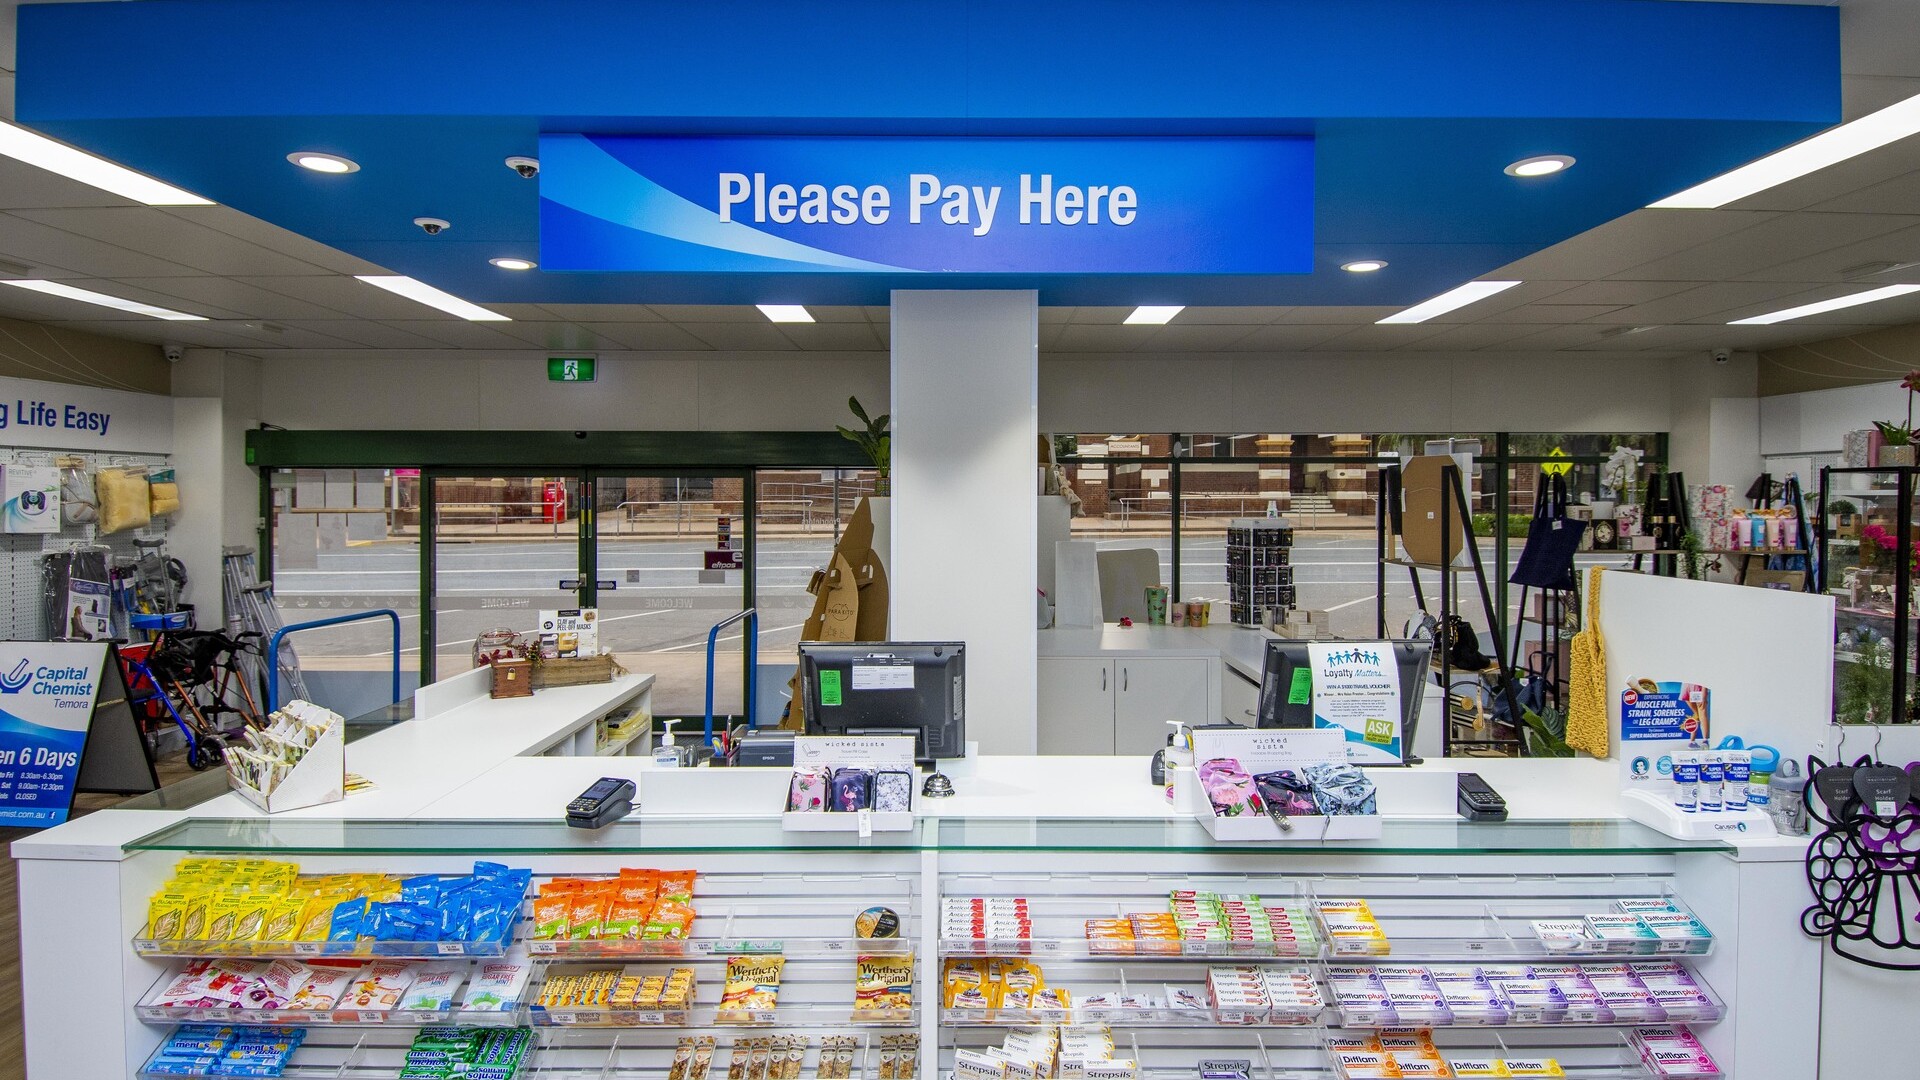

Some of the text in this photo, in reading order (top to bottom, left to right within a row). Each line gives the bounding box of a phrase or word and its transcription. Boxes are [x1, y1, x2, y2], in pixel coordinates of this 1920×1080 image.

[719, 172, 1137, 236] Please Pay Here
[17, 400, 57, 427] Life
[64, 404, 110, 436] Easy
[711, 560, 736, 569] eftpos
[36, 666, 88, 681] Capital
[1324, 668, 1353, 678] Loyalty
[32, 682, 93, 696] Chemist
[53, 698, 89, 709] Temora
[1635, 700, 1660, 708] MUSCLE
[1653, 708, 1685, 717] SORENESS
[1639, 718, 1651, 726] LEG
[1367, 720, 1391, 735] ASK
[19, 747, 32, 766] 6
[34, 747, 78, 771] Days
[15, 793, 38, 801] CLOSED
[1538, 922, 1582, 931] Strepsils
[860, 963, 911, 974] Werther's
[499, 973, 515, 981] FREE
[872, 972, 909, 985] Original
[1640, 1028, 1673, 1036] Difflam
[1009, 1034, 1030, 1044] Strepsils
[1382, 1038, 1416, 1046] Difflam
[991, 1047, 1012, 1058] Strepsils
[1007, 1043, 1028, 1053] Strepsils
[960, 1050, 981, 1059] Strepsils
[1655, 1051, 1690, 1060] Difflam
[1343, 1055, 1378, 1064] Difflam
[958, 1061, 1001, 1078] Strepsils
[1204, 1061, 1245, 1072] Strepsils
[1397, 1062, 1430, 1070] Difflam
[1454, 1062, 1489, 1070] Difflam
[1507, 1061, 1542, 1070] Difflam
[1087, 1071, 1131, 1079] Strepsils
